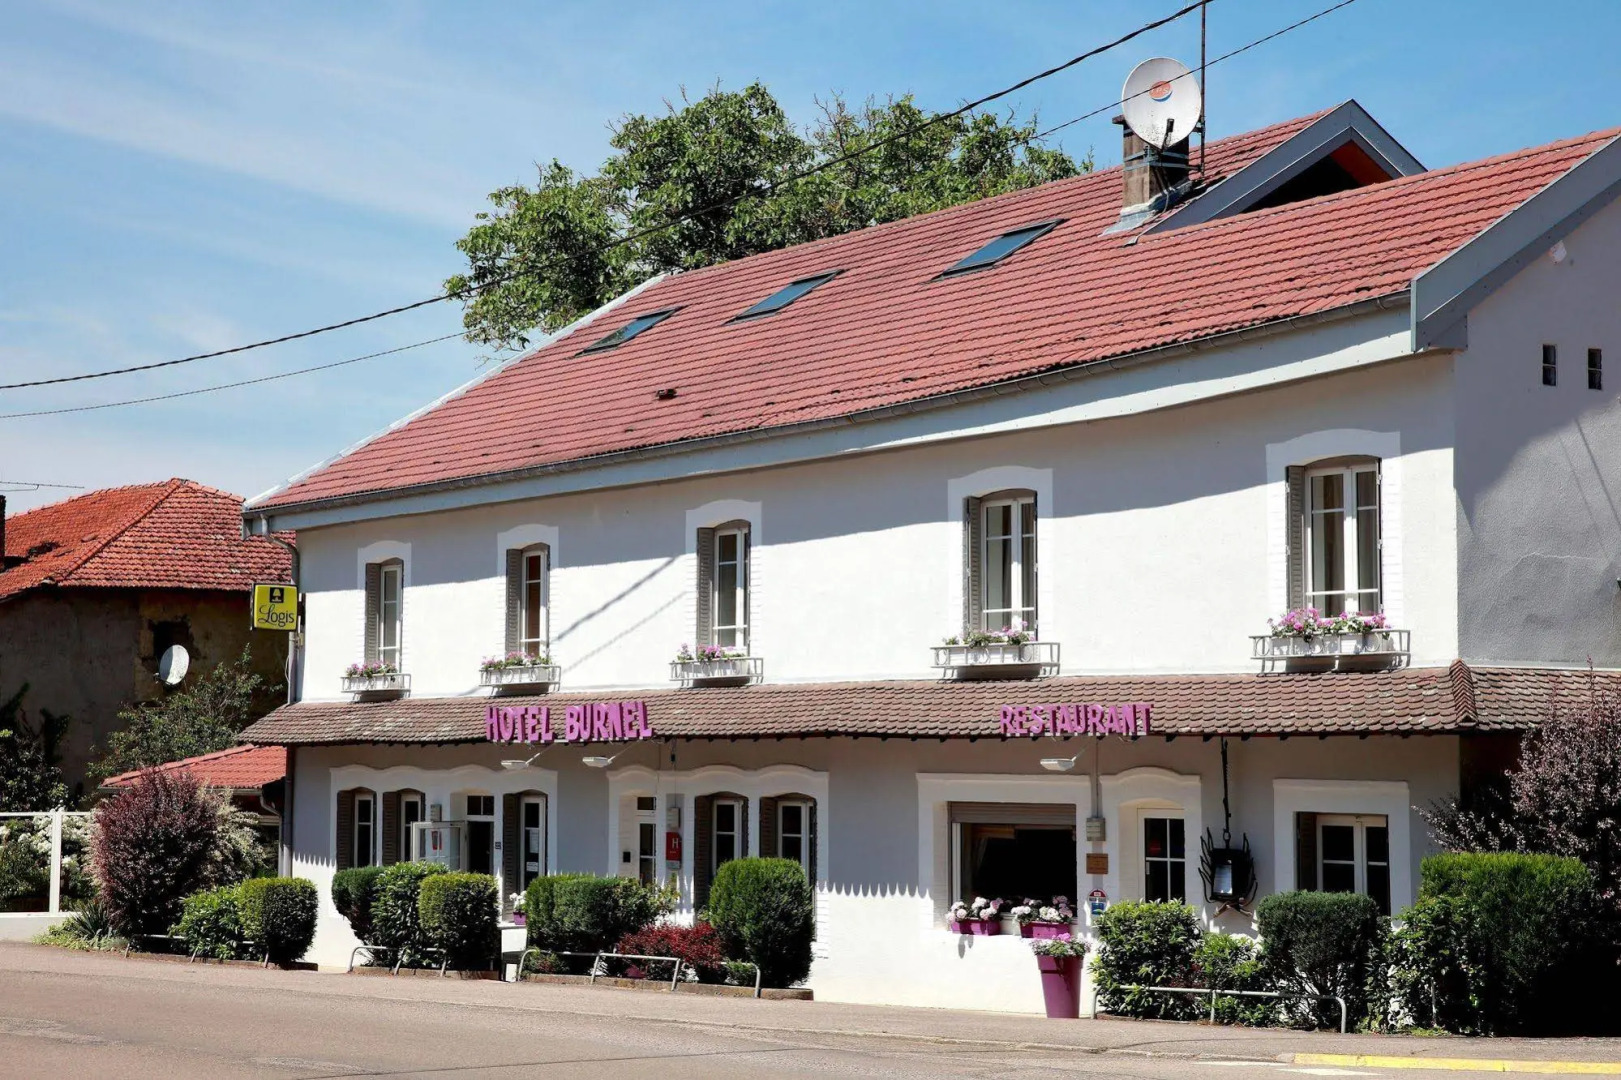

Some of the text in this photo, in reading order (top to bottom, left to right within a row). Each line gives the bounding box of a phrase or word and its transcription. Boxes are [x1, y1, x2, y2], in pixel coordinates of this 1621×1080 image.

[257, 604, 295, 627] Logis
[486, 701, 653, 742] HOTEL BURNEL
[1000, 704, 1154, 735] RESTAURANT
[672, 837, 679, 849] H
